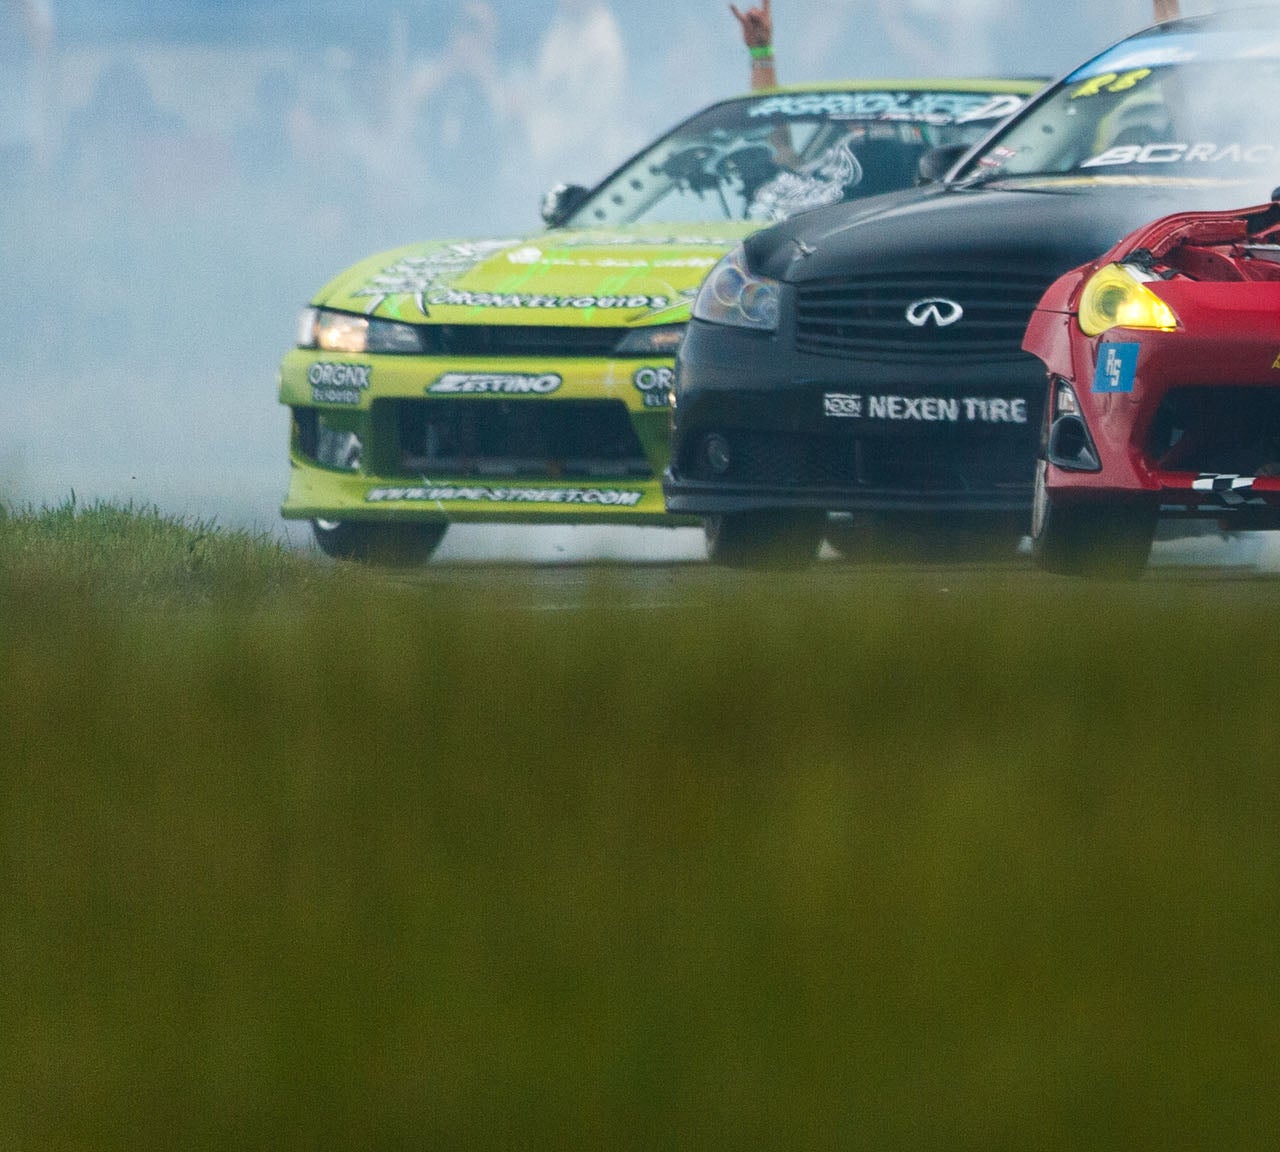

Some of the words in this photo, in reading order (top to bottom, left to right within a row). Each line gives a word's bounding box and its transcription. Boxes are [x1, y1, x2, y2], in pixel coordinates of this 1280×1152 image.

[309, 363, 370, 388] ORGNX
[430, 373, 561, 393] ZESTINO
[869, 396, 958, 421] NEXEN
[964, 398, 1028, 423] TIRE
